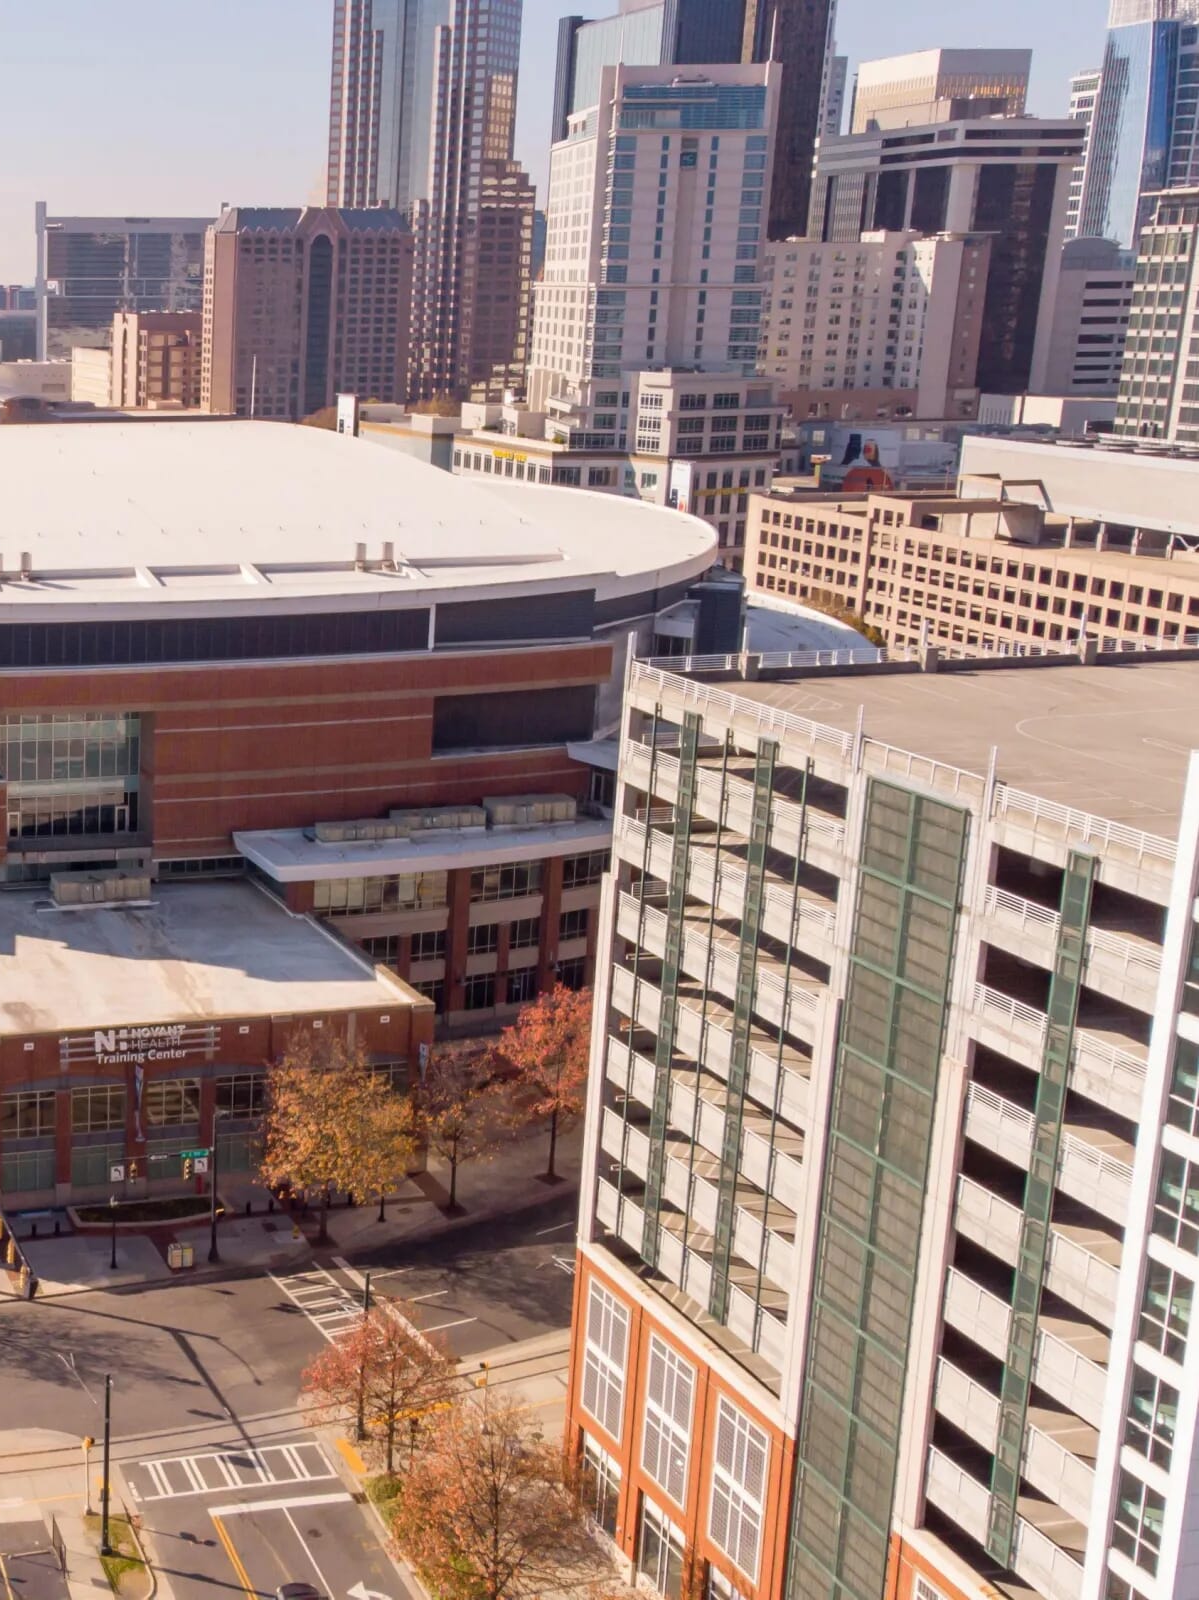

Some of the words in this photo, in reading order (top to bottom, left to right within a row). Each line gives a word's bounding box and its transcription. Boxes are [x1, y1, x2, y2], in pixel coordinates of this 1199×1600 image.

[131, 1025, 186, 1039] NOVANT
[131, 1036, 181, 1049] HEALTH
[96, 1052, 145, 1064] Training
[148, 1049, 187, 1060] Center
